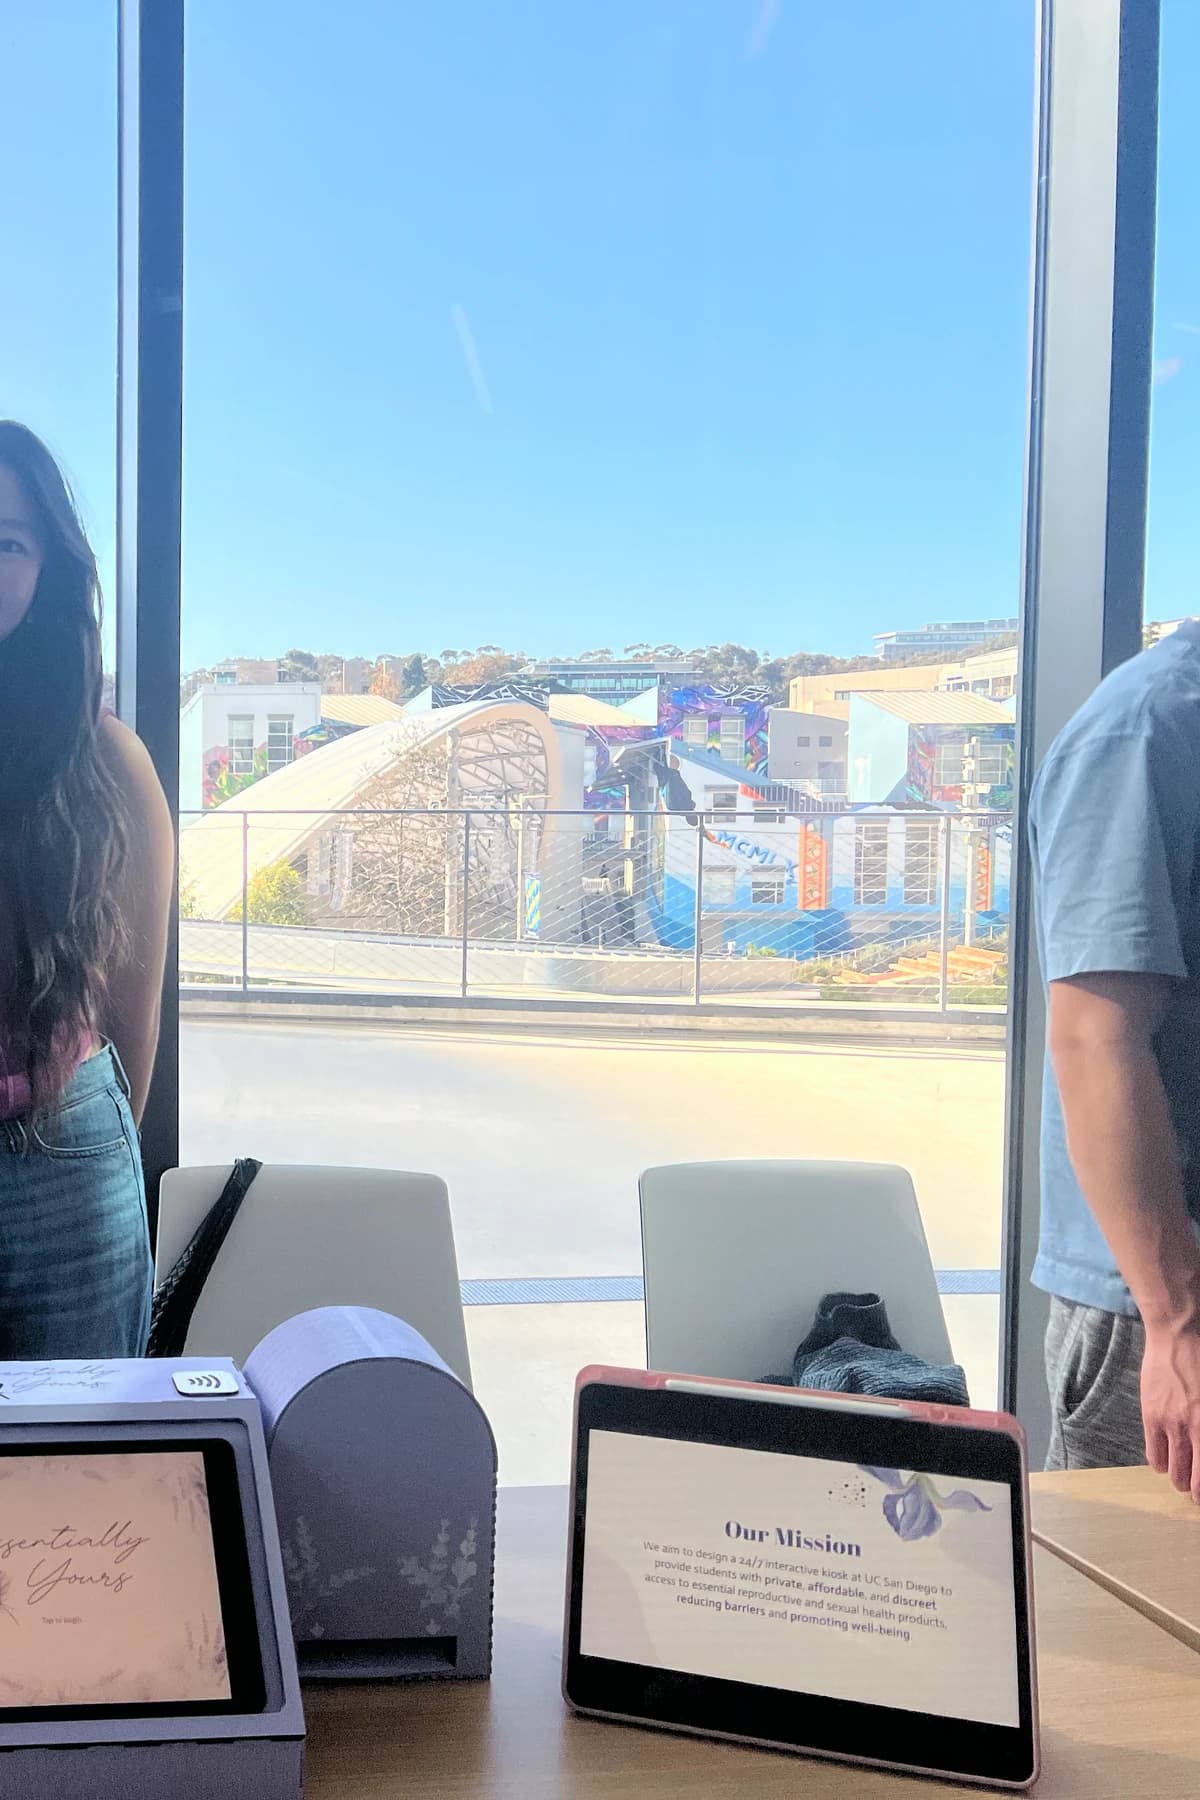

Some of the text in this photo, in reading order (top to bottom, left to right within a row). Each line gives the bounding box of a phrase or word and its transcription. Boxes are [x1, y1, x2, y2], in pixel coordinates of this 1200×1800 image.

[725, 1520, 861, 1557] Our Mission
[26, 1557, 133, 1605] Yours
[643, 1541, 953, 1597] We aim to design a 24/7 interactive kiosk at UC San Diego to
[655, 1559, 937, 1611] provide students with private, affordable, and discreet
[645, 1574, 676, 1586] access
[679, 1577, 689, 1588] to
[692, 1579, 736, 1595] essential
[738, 1588, 801, 1606] reproductive
[805, 1597, 824, 1609] and
[827, 1601, 860, 1615] sexual
[862, 1606, 895, 1621] health
[677, 1593, 722, 1611] reducing
[724, 1600, 766, 1616] barriers
[768, 1606, 787, 1620] and
[790, 1613, 848, 1632] promoting
